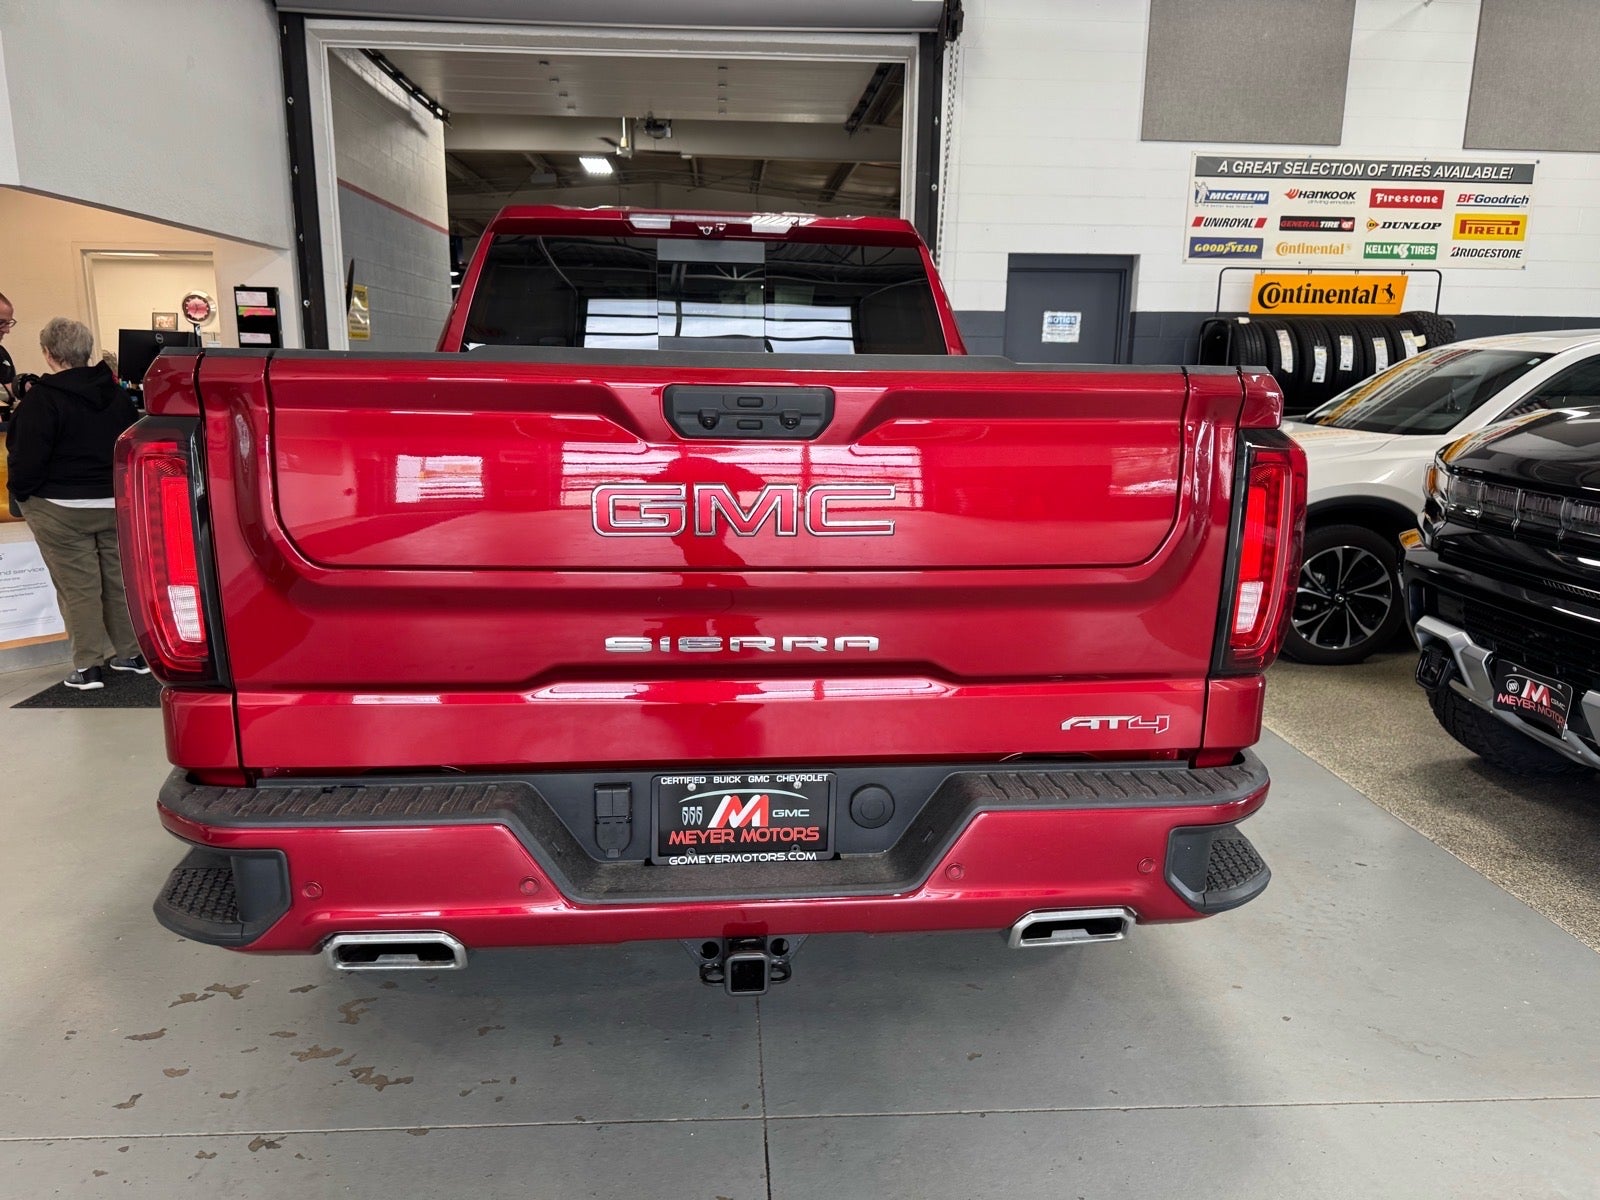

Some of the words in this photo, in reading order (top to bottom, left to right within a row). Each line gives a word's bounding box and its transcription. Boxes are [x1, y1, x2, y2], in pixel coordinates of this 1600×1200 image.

[1217, 160, 1229, 173] A
[1232, 161, 1282, 174] GREAT
[1283, 161, 1364, 176] SELECTION
[1367, 164, 1388, 177] OF
[1391, 164, 1431, 178] TIRES
[1433, 165, 1514, 180] AVAILABLE!
[1209, 192, 1267, 201] MICHELIN
[1375, 193, 1439, 204] Firestone
[1457, 194, 1530, 205] BFGoodrich
[1203, 217, 1255, 228] UNIROYAL
[1381, 221, 1442, 230] DUNLOP
[1459, 219, 1521, 235] PIRELLI
[1194, 241, 1259, 254] GOODYEAR
[1275, 242, 1345, 256] Continental
[1365, 244, 1393, 254] KELLY
[1410, 245, 1437, 255] TIRES
[1450, 247, 1523, 259] BRIDGESTONE
[1257, 281, 1379, 309] Continental
[591, 482, 898, 538] GMC
[604, 635, 880, 653] SIERRA
[1496, 692, 1537, 712] MEYER
[1060, 715, 1170, 734] AT4
[660, 776, 707, 785] CERTIFIED
[713, 775, 741, 784] BUICK
[747, 775, 770, 783] GMC
[776, 774, 829, 783] CHEVROLET
[772, 808, 810, 818] GMC
[668, 828, 736, 845] MEYER
[739, 826, 820, 843] MOTORS
[668, 851, 817, 866] GOMEYERMOTORS.COM
